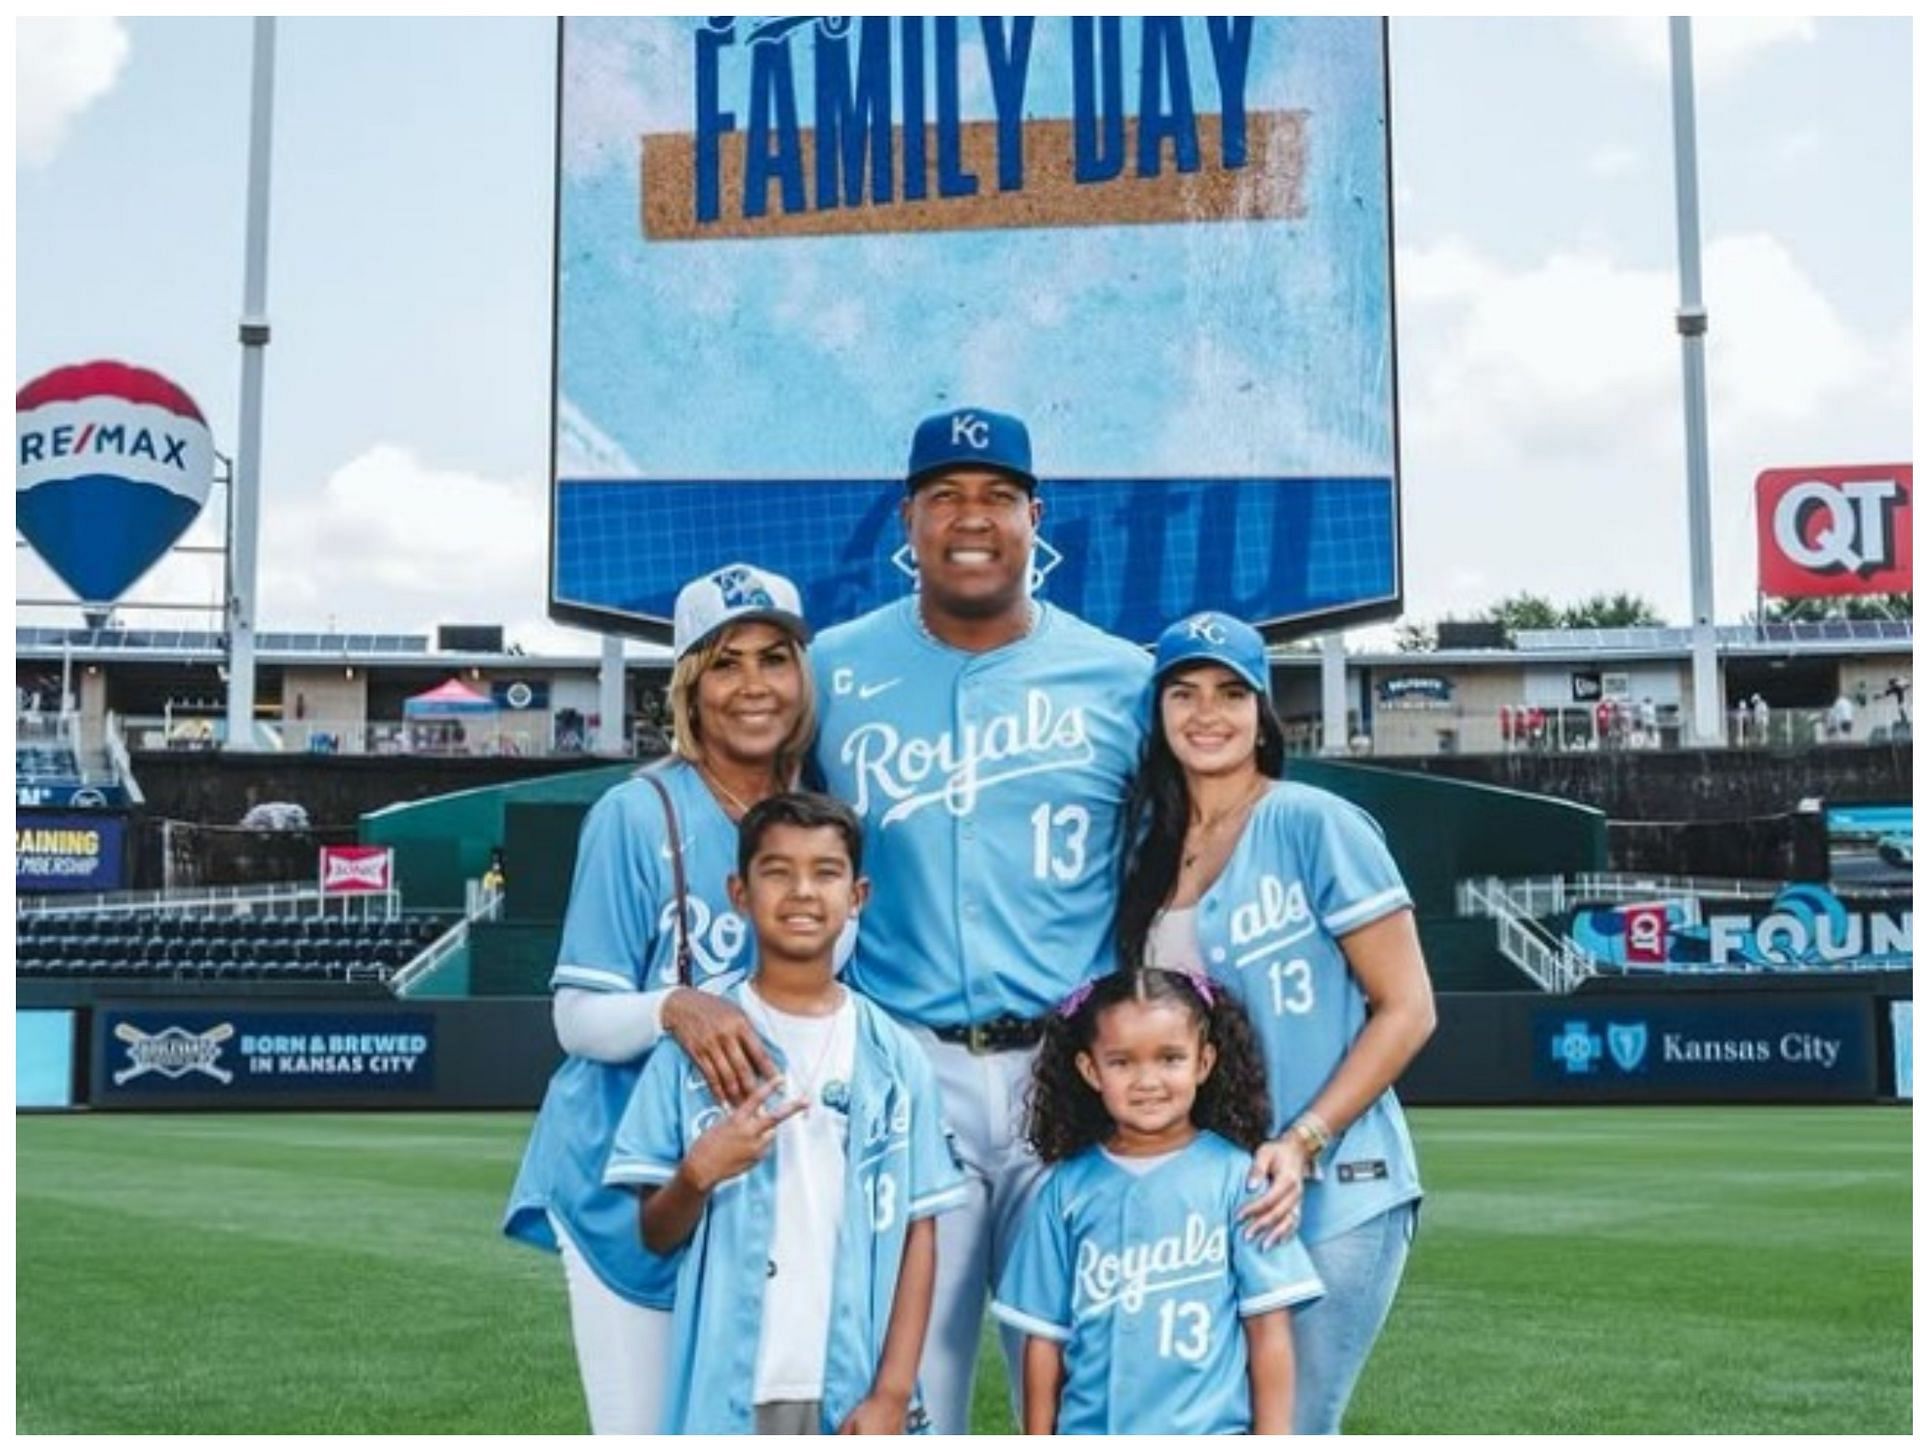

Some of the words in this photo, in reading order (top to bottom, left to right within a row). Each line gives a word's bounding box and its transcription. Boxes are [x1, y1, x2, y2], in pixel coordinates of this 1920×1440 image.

[695, 16, 1034, 224] FAMILY
[1072, 16, 1254, 184] DAY
[20, 423, 188, 471] RE/MAX
[951, 414, 989, 449] KC
[1773, 480, 1897, 572] QT
[840, 687, 1096, 830] Royals
[1030, 802, 1091, 881] 13
[1268, 958, 1315, 1016] 13
[241, 1035, 307, 1055] BORN
[329, 1035, 427, 1054] BREWED
[250, 1056, 273, 1073] IN
[279, 1056, 363, 1073] KANSAS
[369, 1056, 417, 1073] CITY
[1663, 1033, 1771, 1062] Kansas
[1780, 1033, 1841, 1069] City
[1072, 1213, 1228, 1322] Royals
[1159, 1299, 1210, 1360] 13
